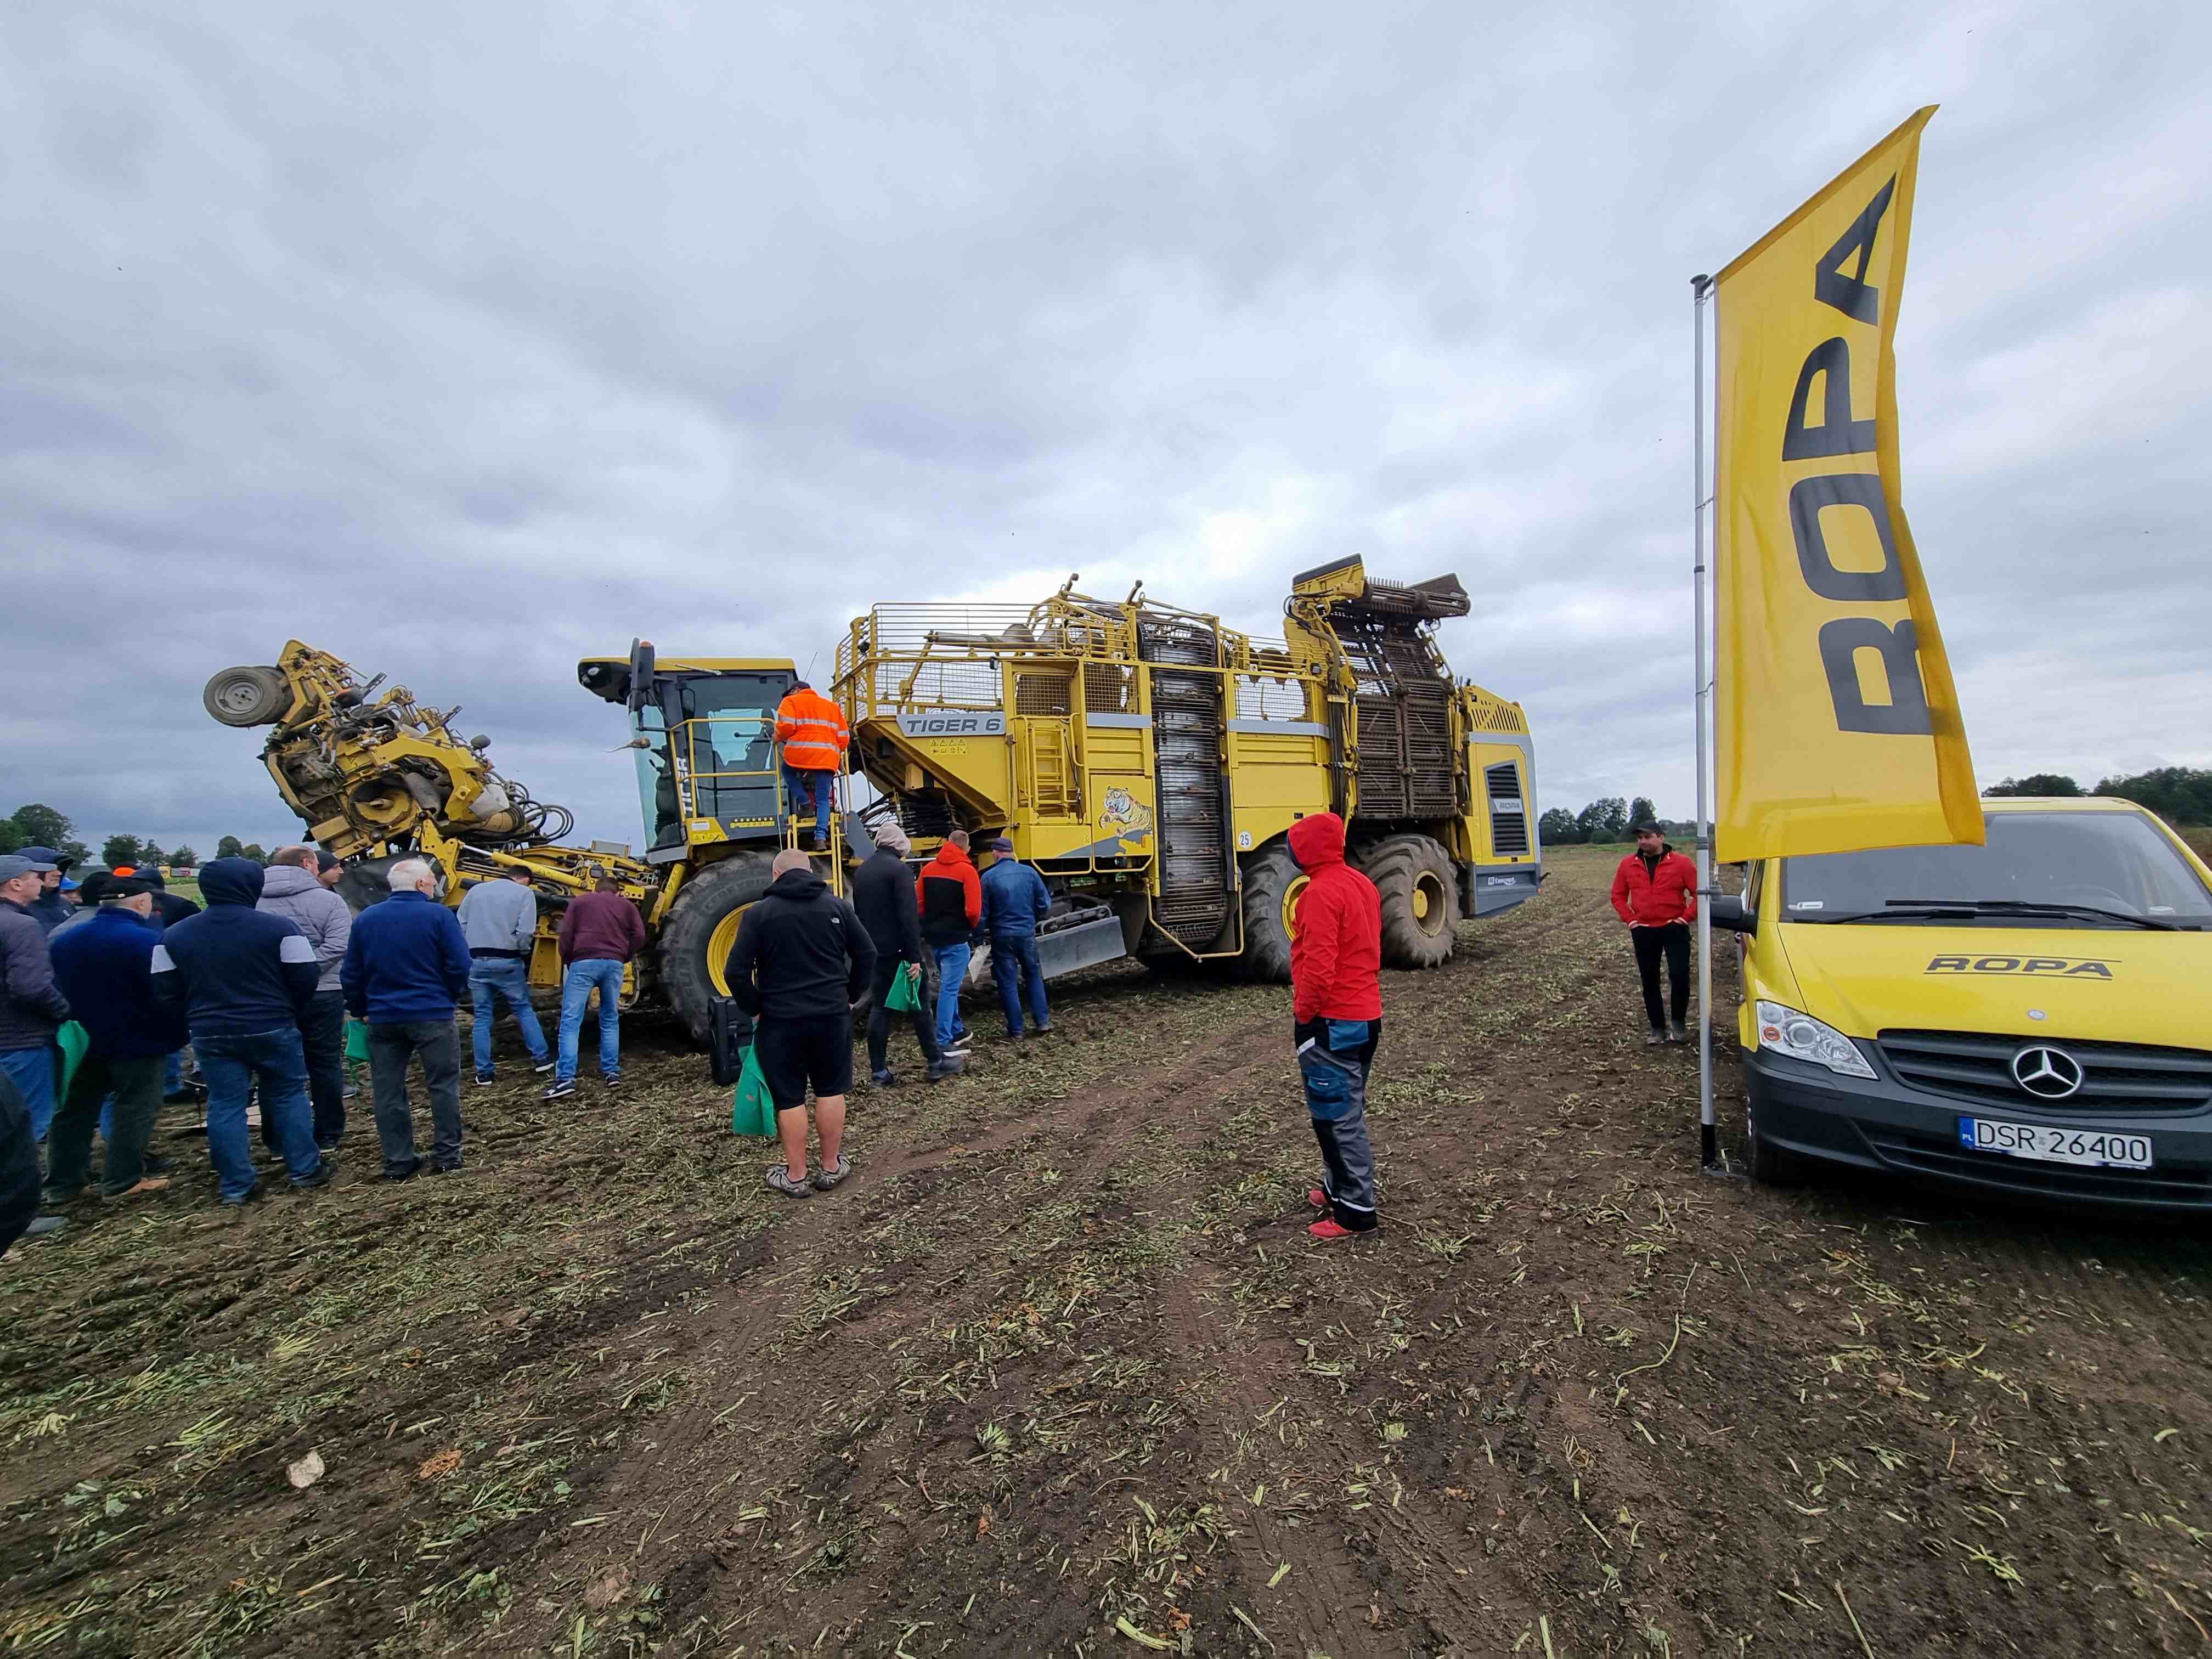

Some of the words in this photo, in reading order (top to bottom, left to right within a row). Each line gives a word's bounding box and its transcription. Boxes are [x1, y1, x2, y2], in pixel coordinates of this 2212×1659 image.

[1781, 171, 1934, 736] ROPA
[906, 719, 978, 732] TIGER
[985, 718, 1001, 731] 6
[1240, 834, 1249, 845] 25
[1926, 957, 2113, 977] ROPA
[1977, 1122, 2036, 1151] DSR
[2049, 1131, 2147, 1162] 26400
